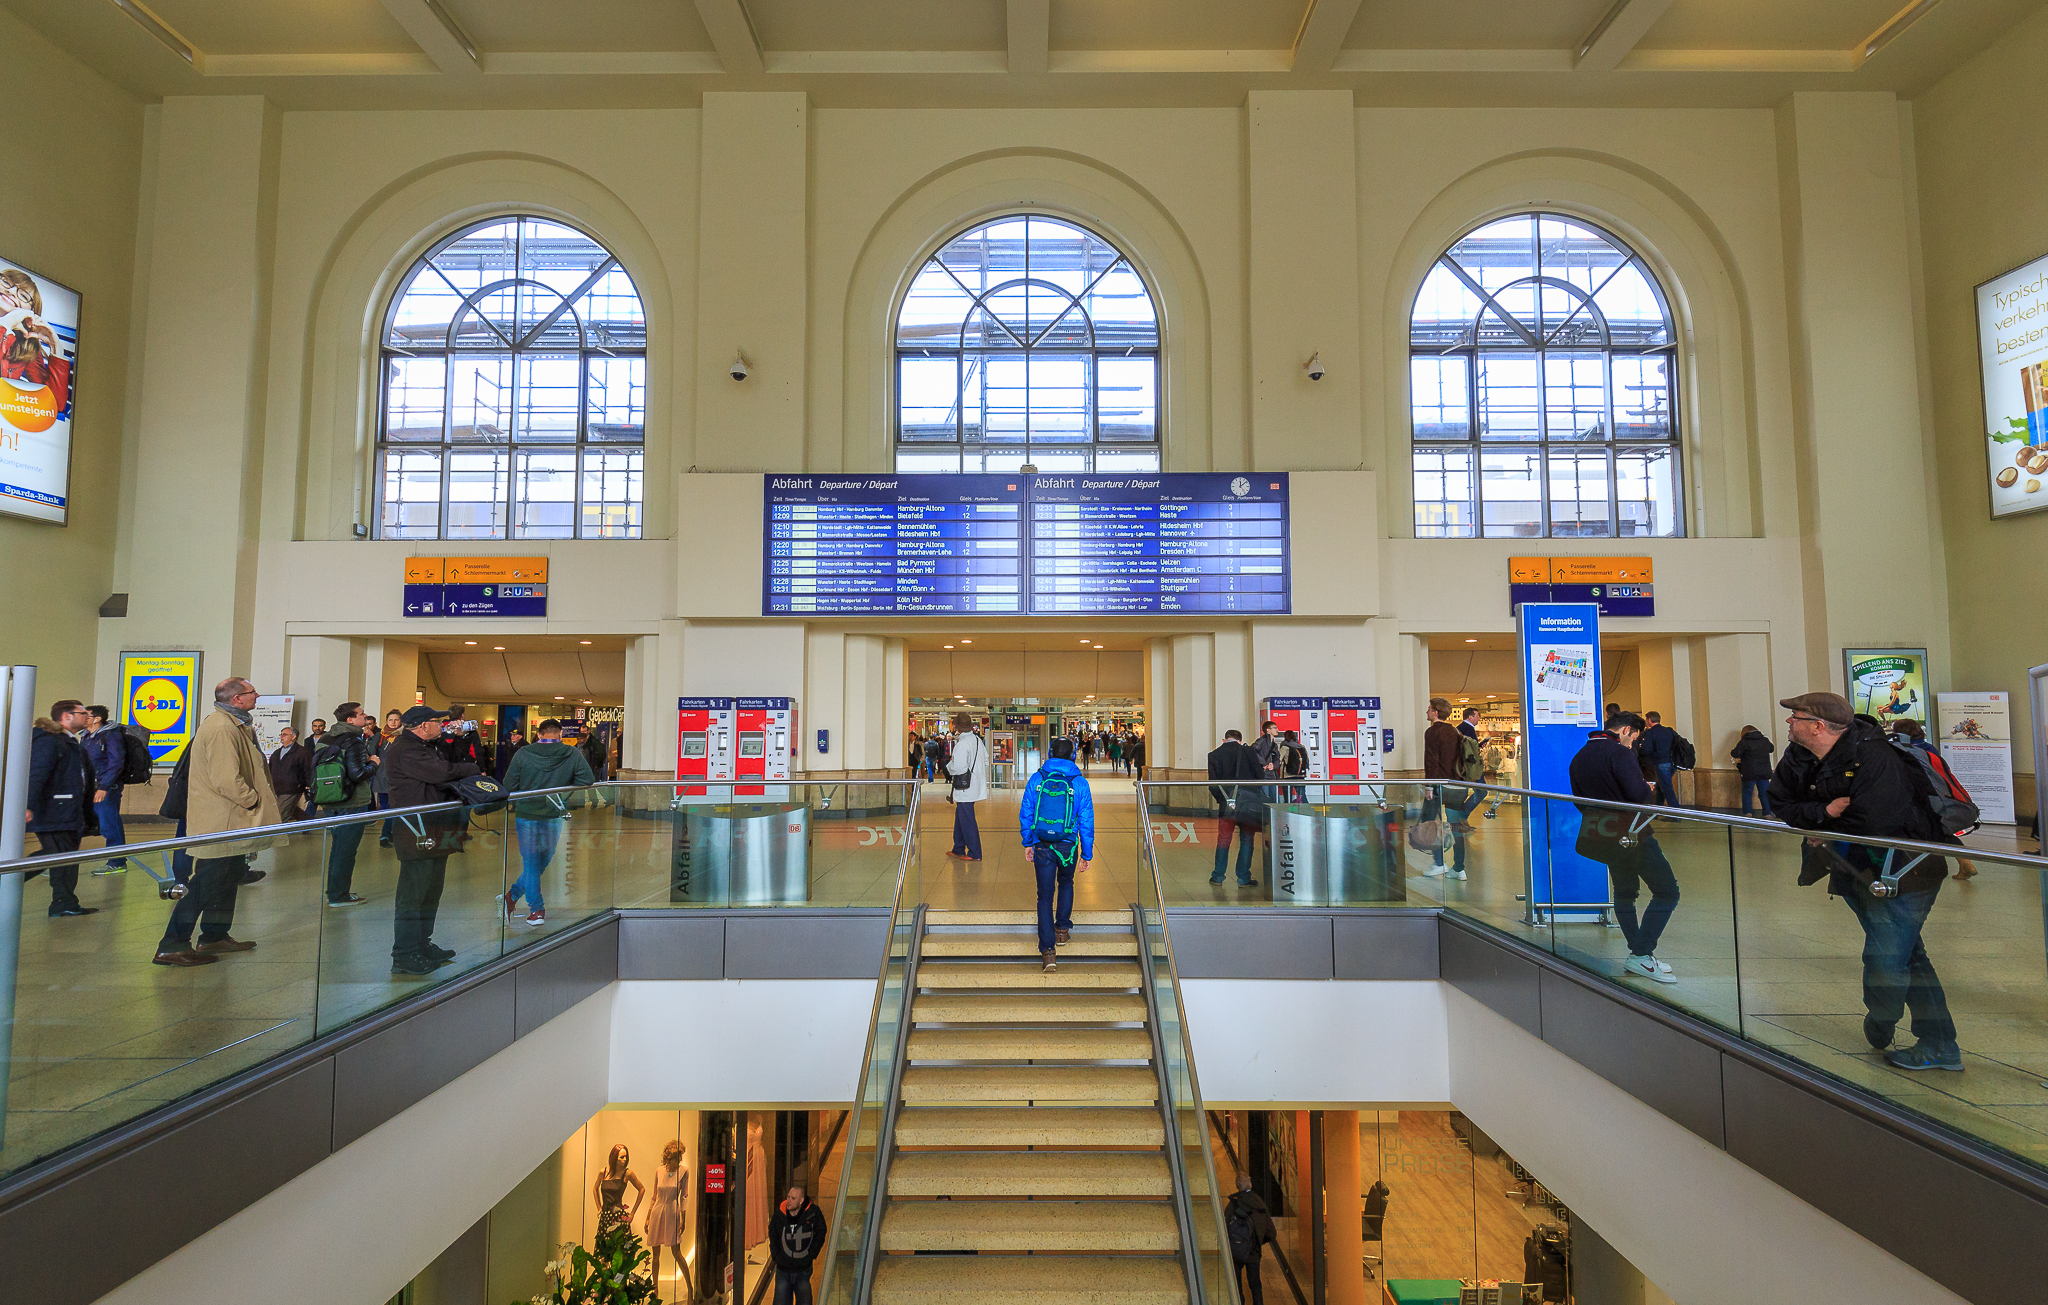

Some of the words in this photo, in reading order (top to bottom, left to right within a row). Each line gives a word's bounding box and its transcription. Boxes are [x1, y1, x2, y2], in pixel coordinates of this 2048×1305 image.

[15, 393, 39, 404] Jetzt
[0, 403, 55, 418] umsteigen!
[772, 478, 813, 489] Abfahrt
[819, 480, 862, 490] Departure
[868, 480, 898, 490] Départ
[1034, 478, 1075, 489] Abfahrt
[1081, 480, 1124, 490] Departure
[1131, 480, 1160, 489] Départ
[4, 485, 59, 504] Sparda-Bank
[897, 505, 945, 513] Hamburg-Altona
[897, 541, 945, 549] Hamburg-Altona
[1160, 540, 1208, 548] Hamburg-Altona
[896, 560, 908, 568] Bad
[909, 560, 936, 568] Pyrmont
[1540, 617, 1582, 626] Information
[1853, 660, 1881, 673] SPIELEND
[678, 838, 691, 896] Abfall
[1280, 838, 1295, 895] Abfall
[1383, 1152, 1469, 1175] PREISE
